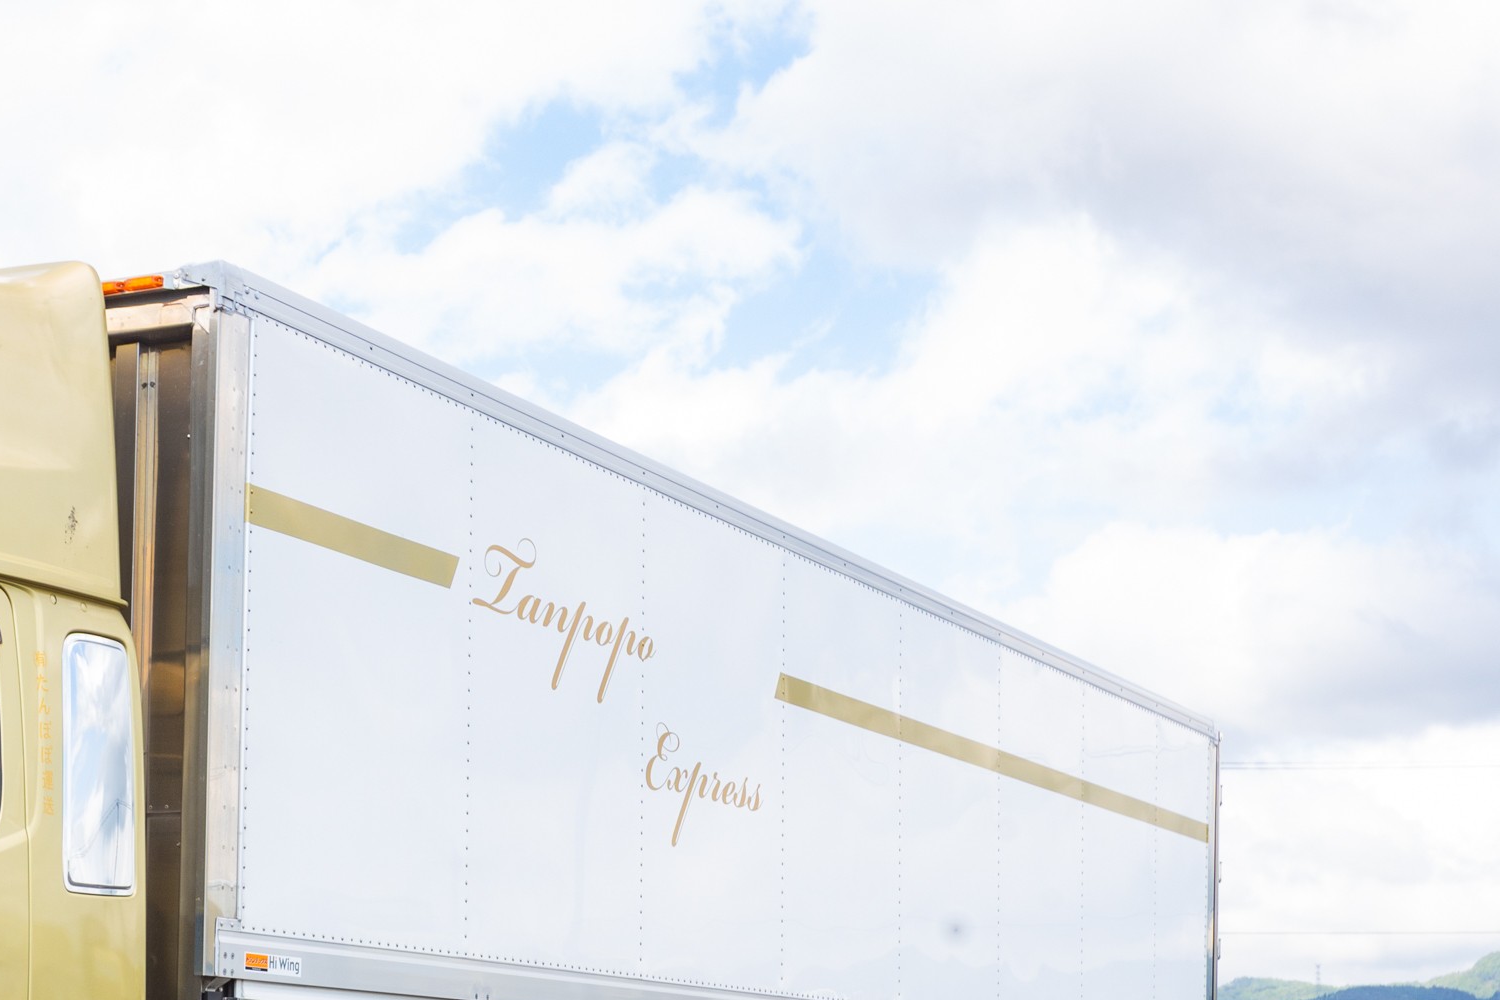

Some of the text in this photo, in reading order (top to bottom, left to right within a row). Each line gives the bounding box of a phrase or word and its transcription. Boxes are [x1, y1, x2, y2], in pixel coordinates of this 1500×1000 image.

[471, 538, 657, 703] Tanpopo
[645, 722, 763, 847] Express
[269, 956, 300, 975] Hi Wing
